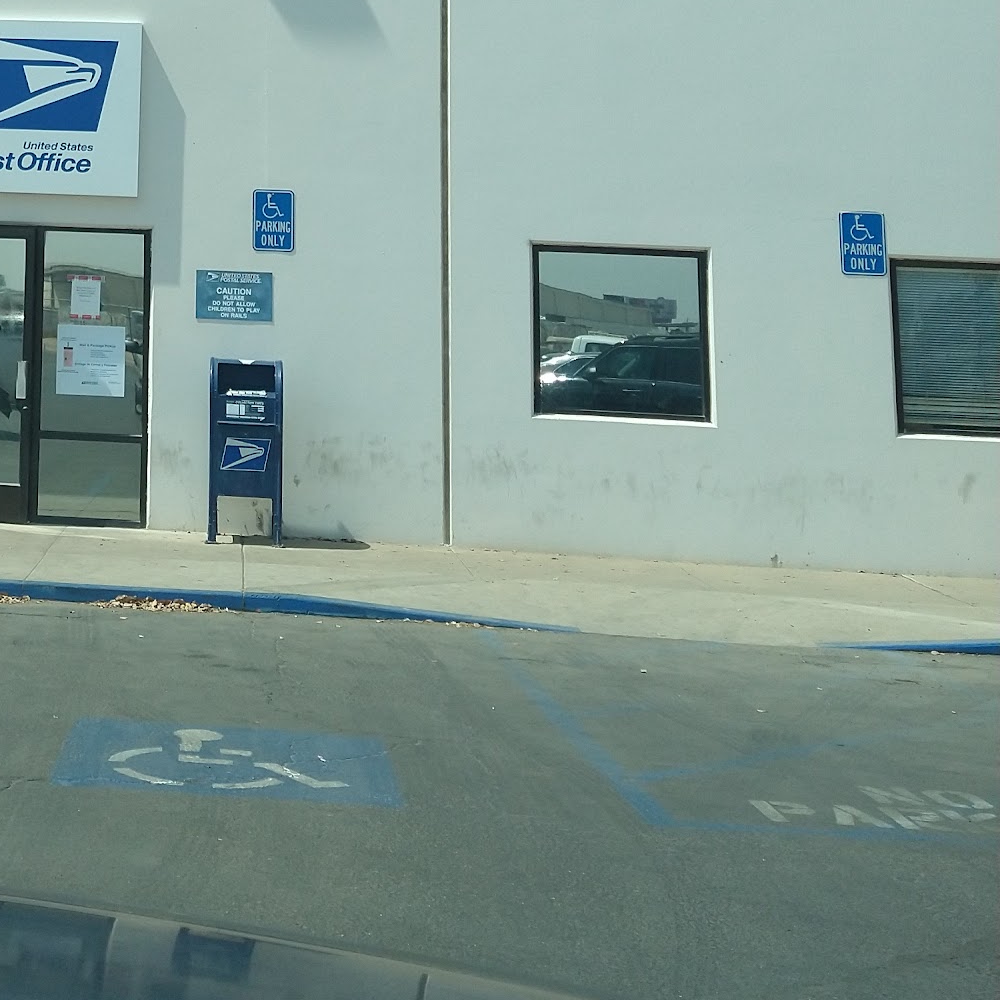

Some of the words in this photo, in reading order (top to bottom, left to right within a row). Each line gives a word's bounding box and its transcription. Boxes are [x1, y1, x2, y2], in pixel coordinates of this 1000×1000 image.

[22, 140, 58, 151] United
[59, 142, 94, 152] States
[17, 151, 92, 173] Office
[255, 220, 291, 233] PARKING
[261, 234, 285, 247] ONLY
[843, 242, 883, 257] PARKING
[850, 257, 877, 271] ONLY
[216, 287, 252, 296] CAUTION
[857, 784, 994, 810] NO
